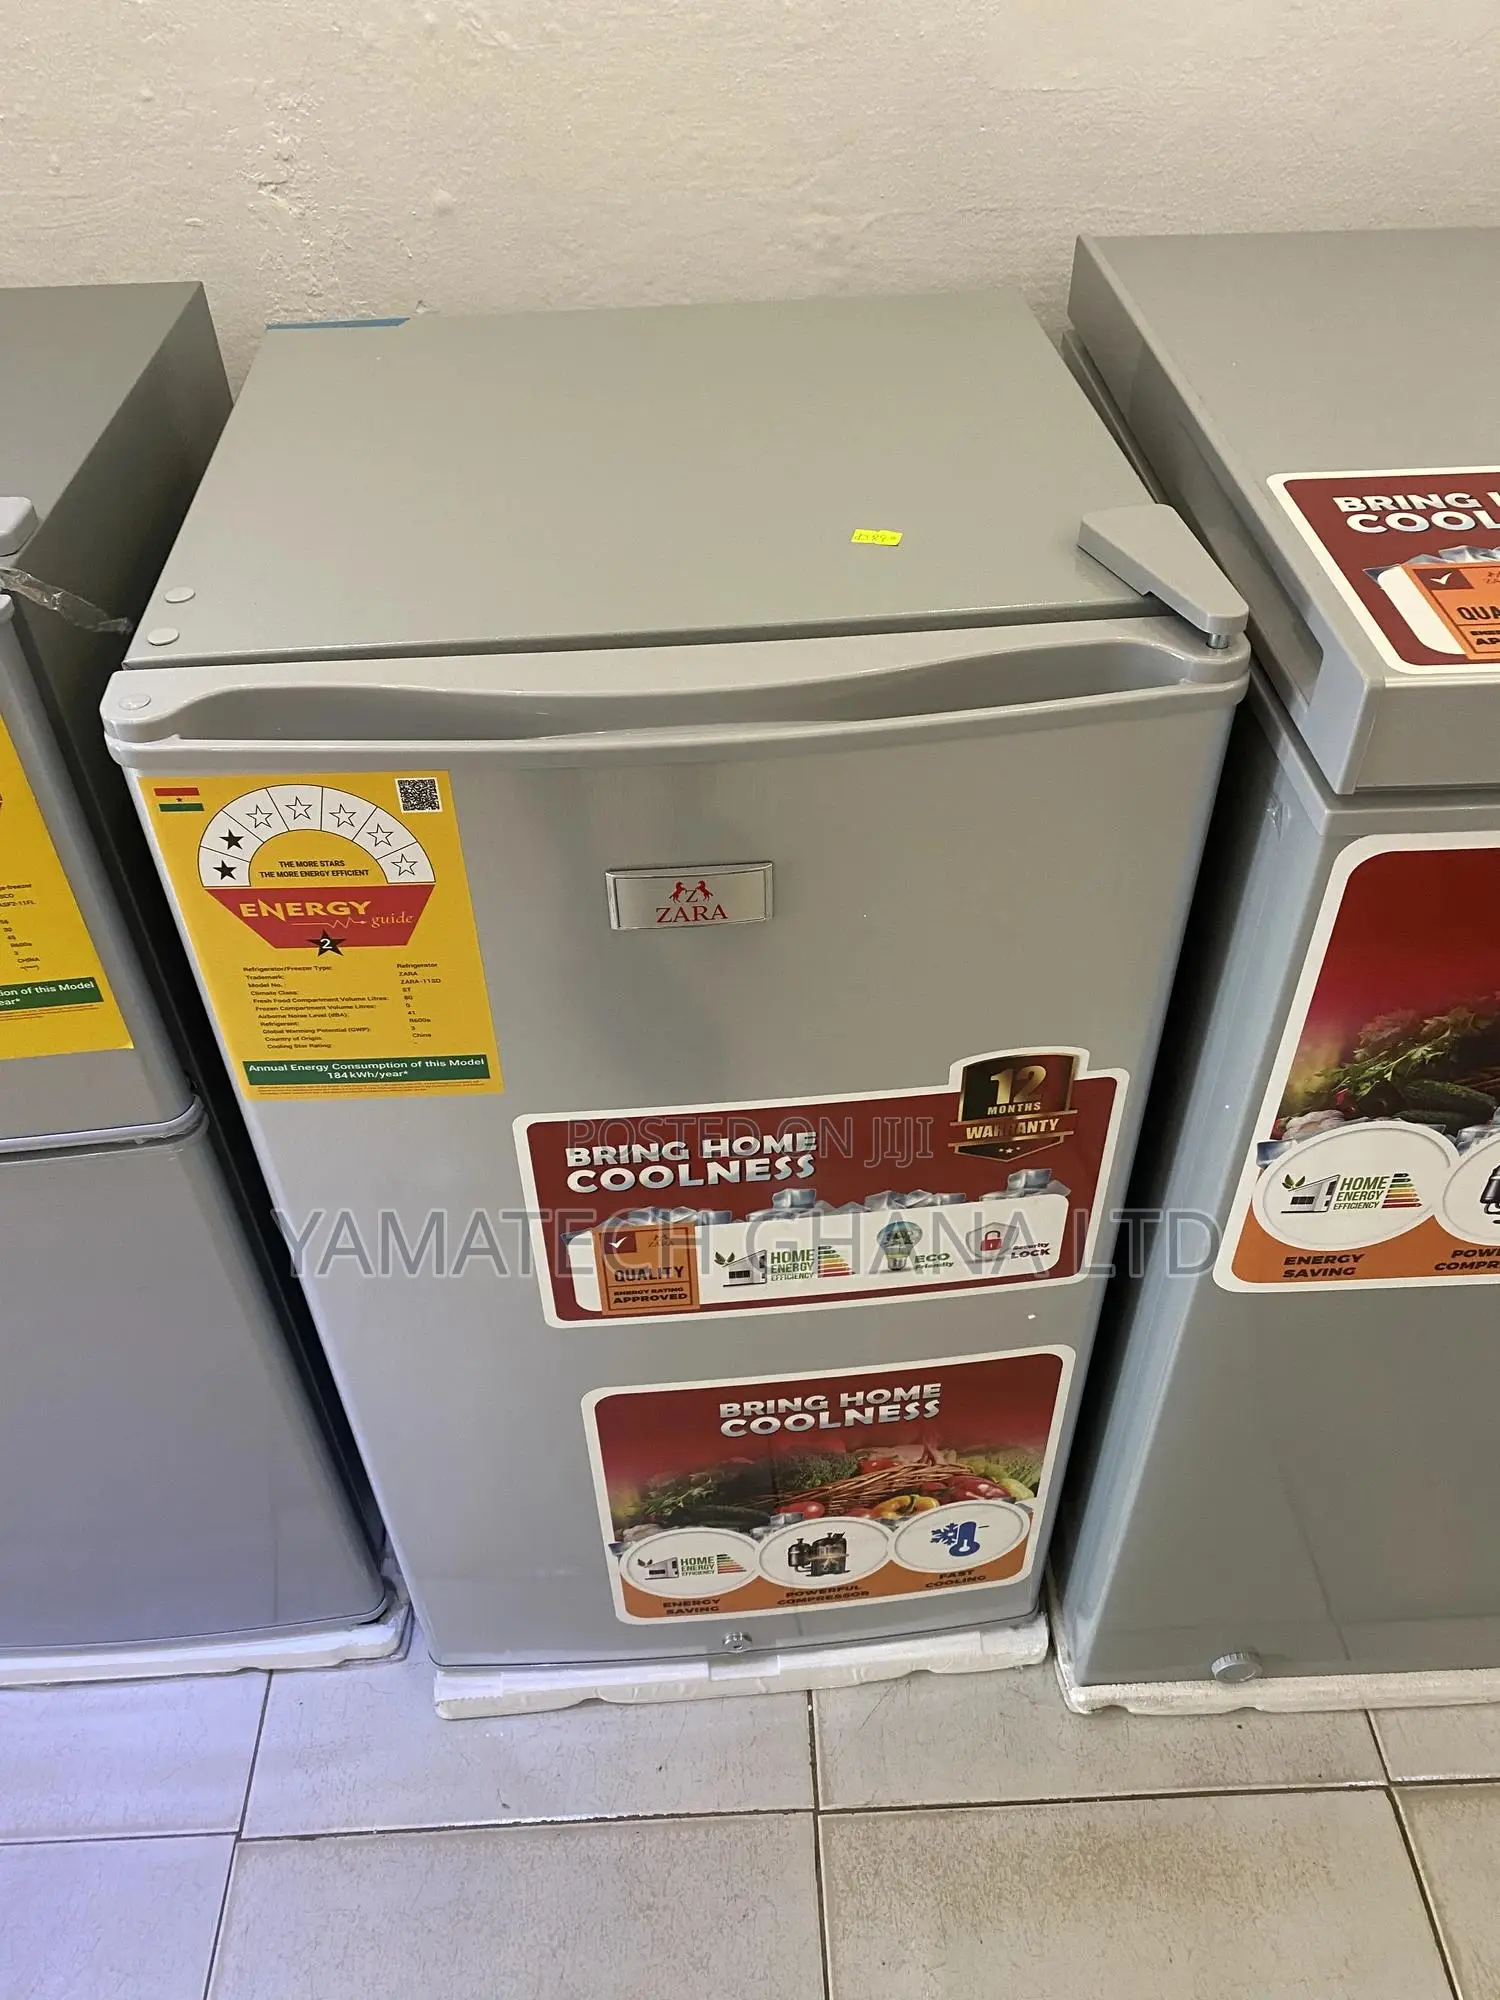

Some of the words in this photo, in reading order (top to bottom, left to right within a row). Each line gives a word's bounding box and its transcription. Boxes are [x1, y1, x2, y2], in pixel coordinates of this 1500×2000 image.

[1332, 492, 1482, 512] BRING
[295, 860, 319, 868] MORE
[276, 870, 300, 878] MORE
[332, 869, 369, 877] EFFICIENT
[239, 898, 372, 922] ENERGY
[371, 912, 414, 928] guide
[655, 903, 728, 923] ZARA
[320, 938, 333, 949] 2
[20, 986, 32, 996] of
[34, 984, 56, 994] this
[59, 981, 95, 992] Model
[249, 1063, 288, 1072] Annual
[290, 1063, 329, 1072] Energy
[332, 1061, 408, 1071] Consumption
[411, 1060, 422, 1068] of
[449, 1058, 484, 1067] Model
[990, 1065, 1047, 1105] 12
[987, 1101, 1041, 1115] MONTHS
[965, 1118, 1060, 1140] WARRANTY
[565, 1140, 690, 1167] BRING
[702, 1131, 818, 1159] HOME
[566, 1153, 816, 1194] COOLNESS
[1339, 1176, 1390, 1191] HOME
[1336, 1190, 1384, 1202] ENERGY
[1333, 1201, 1380, 1210] EFFICIENCY
[771, 1249, 815, 1265] HOME
[914, 1252, 950, 1264] ECO
[1010, 1248, 1051, 1260] LOCK
[1283, 1253, 1366, 1266] ENERGY
[614, 1265, 684, 1282] QUALITY
[771, 1261, 814, 1275] ENERGY
[1283, 1266, 1356, 1278] SAVING
[771, 1271, 815, 1282] EFFICIENCY
[651, 1286, 683, 1294] RATING
[613, 1292, 688, 1304] APPROVED
[719, 1395, 829, 1419] BRING
[840, 1383, 942, 1408] HOME
[720, 1399, 941, 1437] COOLNESS
[681, 1556, 715, 1566] HOME
[681, 1564, 714, 1572] ENERGY
[925, 1574, 987, 1588] COOLING
[938, 1569, 976, 1580] FAST
[777, 1590, 871, 1606] COMPRESSOR
[785, 1584, 860, 1599] POWERFUL
[663, 1598, 721, 1609] ENERGY
[666, 1605, 720, 1615] SAVING
